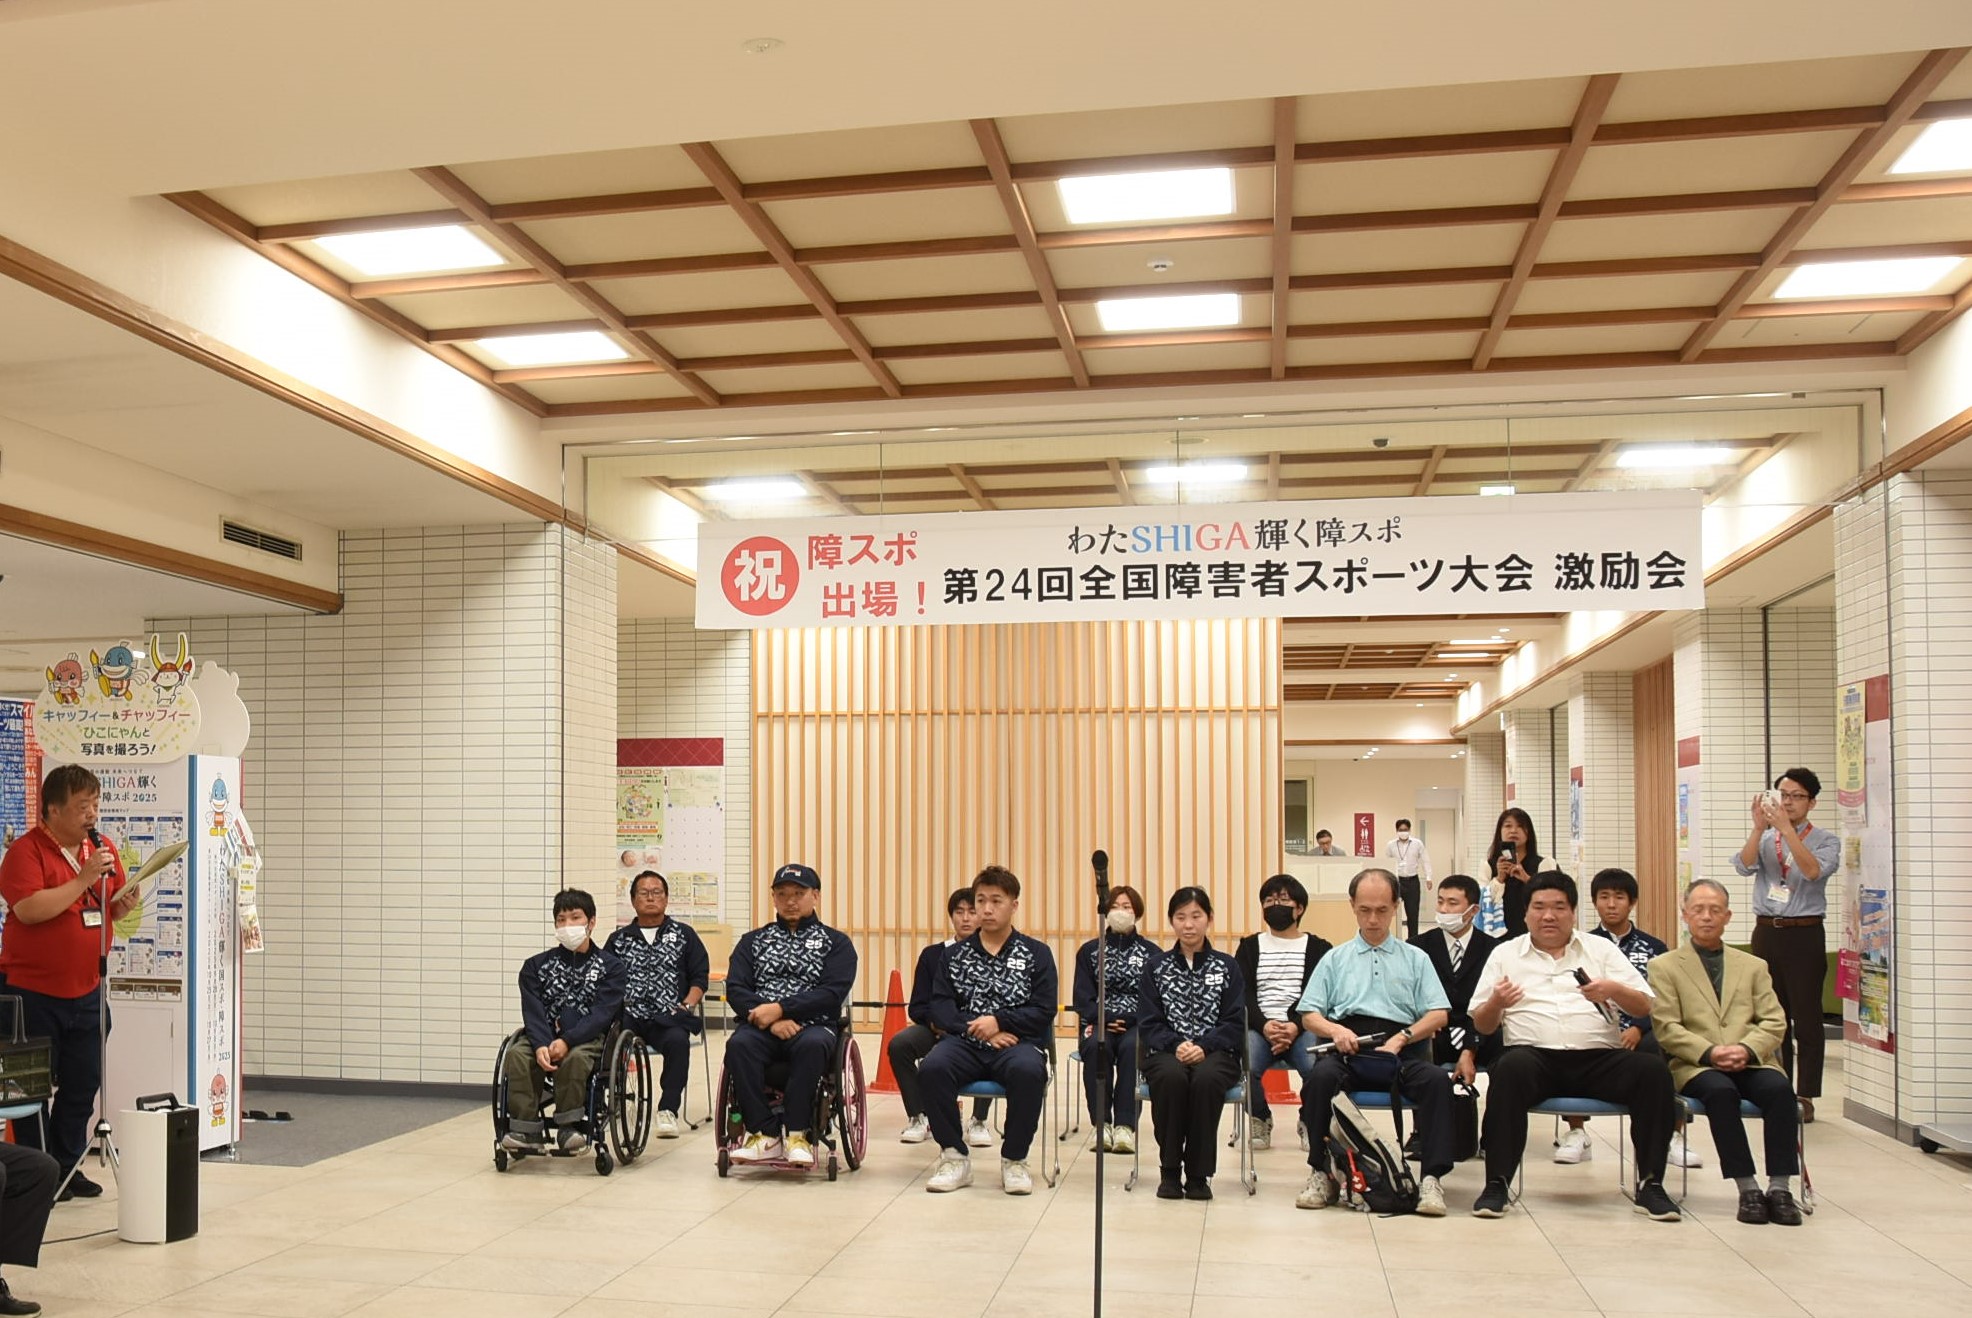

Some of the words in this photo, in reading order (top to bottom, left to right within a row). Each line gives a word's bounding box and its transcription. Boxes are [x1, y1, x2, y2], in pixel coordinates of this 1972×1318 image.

[1068, 515, 1402, 555] わたSHIGA輝く障スポ
[807, 530, 918, 570] 障スポ
[733, 548, 786, 602] 祝
[943, 552, 1534, 605] 第24回全国障害者スポーツ大会
[1554, 550, 1687, 591] 激励会
[132, 793, 157, 802] 2025
[805, 939, 823, 949] 25
[1007, 957, 1026, 971] 25
[1128, 956, 1143, 967] 25
[1629, 952, 1648, 963] 25
[1205, 972, 1224, 985] 25
